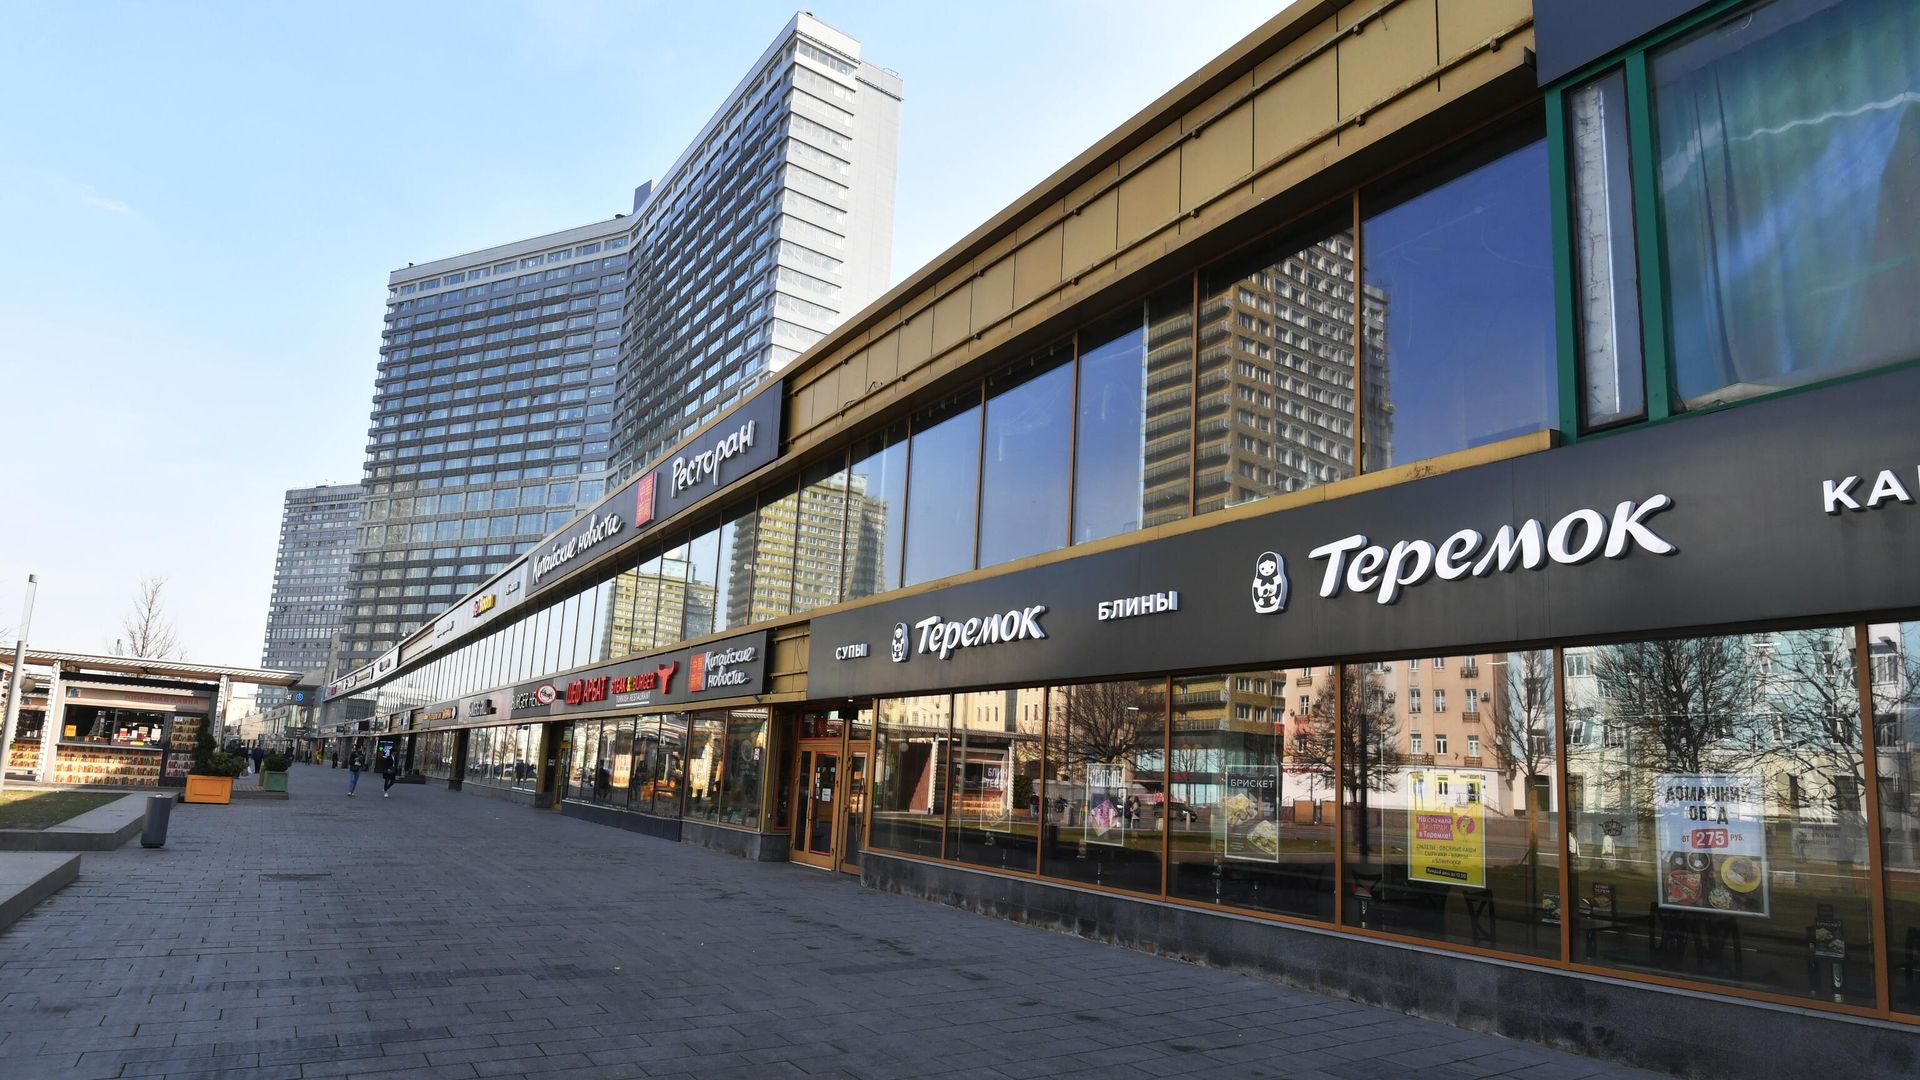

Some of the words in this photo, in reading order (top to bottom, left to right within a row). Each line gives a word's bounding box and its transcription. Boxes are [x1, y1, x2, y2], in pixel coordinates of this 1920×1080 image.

[672, 420, 755, 498] Ресторан
[1823, 465, 1920, 513] КА
[532, 537, 577, 585] Китайские
[577, 513, 625, 554] новости
[1309, 494, 1676, 604] Теремок
[1098, 591, 1179, 621] БЛИНЫ
[915, 605, 1048, 660] Теремок
[705, 647, 759, 671] Китайские
[835, 643, 868, 660] СУПЫ
[583, 676, 608, 702] АРБАТ
[633, 672, 656, 690] BURGER
[708, 665, 750, 687] новости
[1230, 779, 1274, 788] БРИСКЕТ
[1696, 831, 1725, 846] 275
